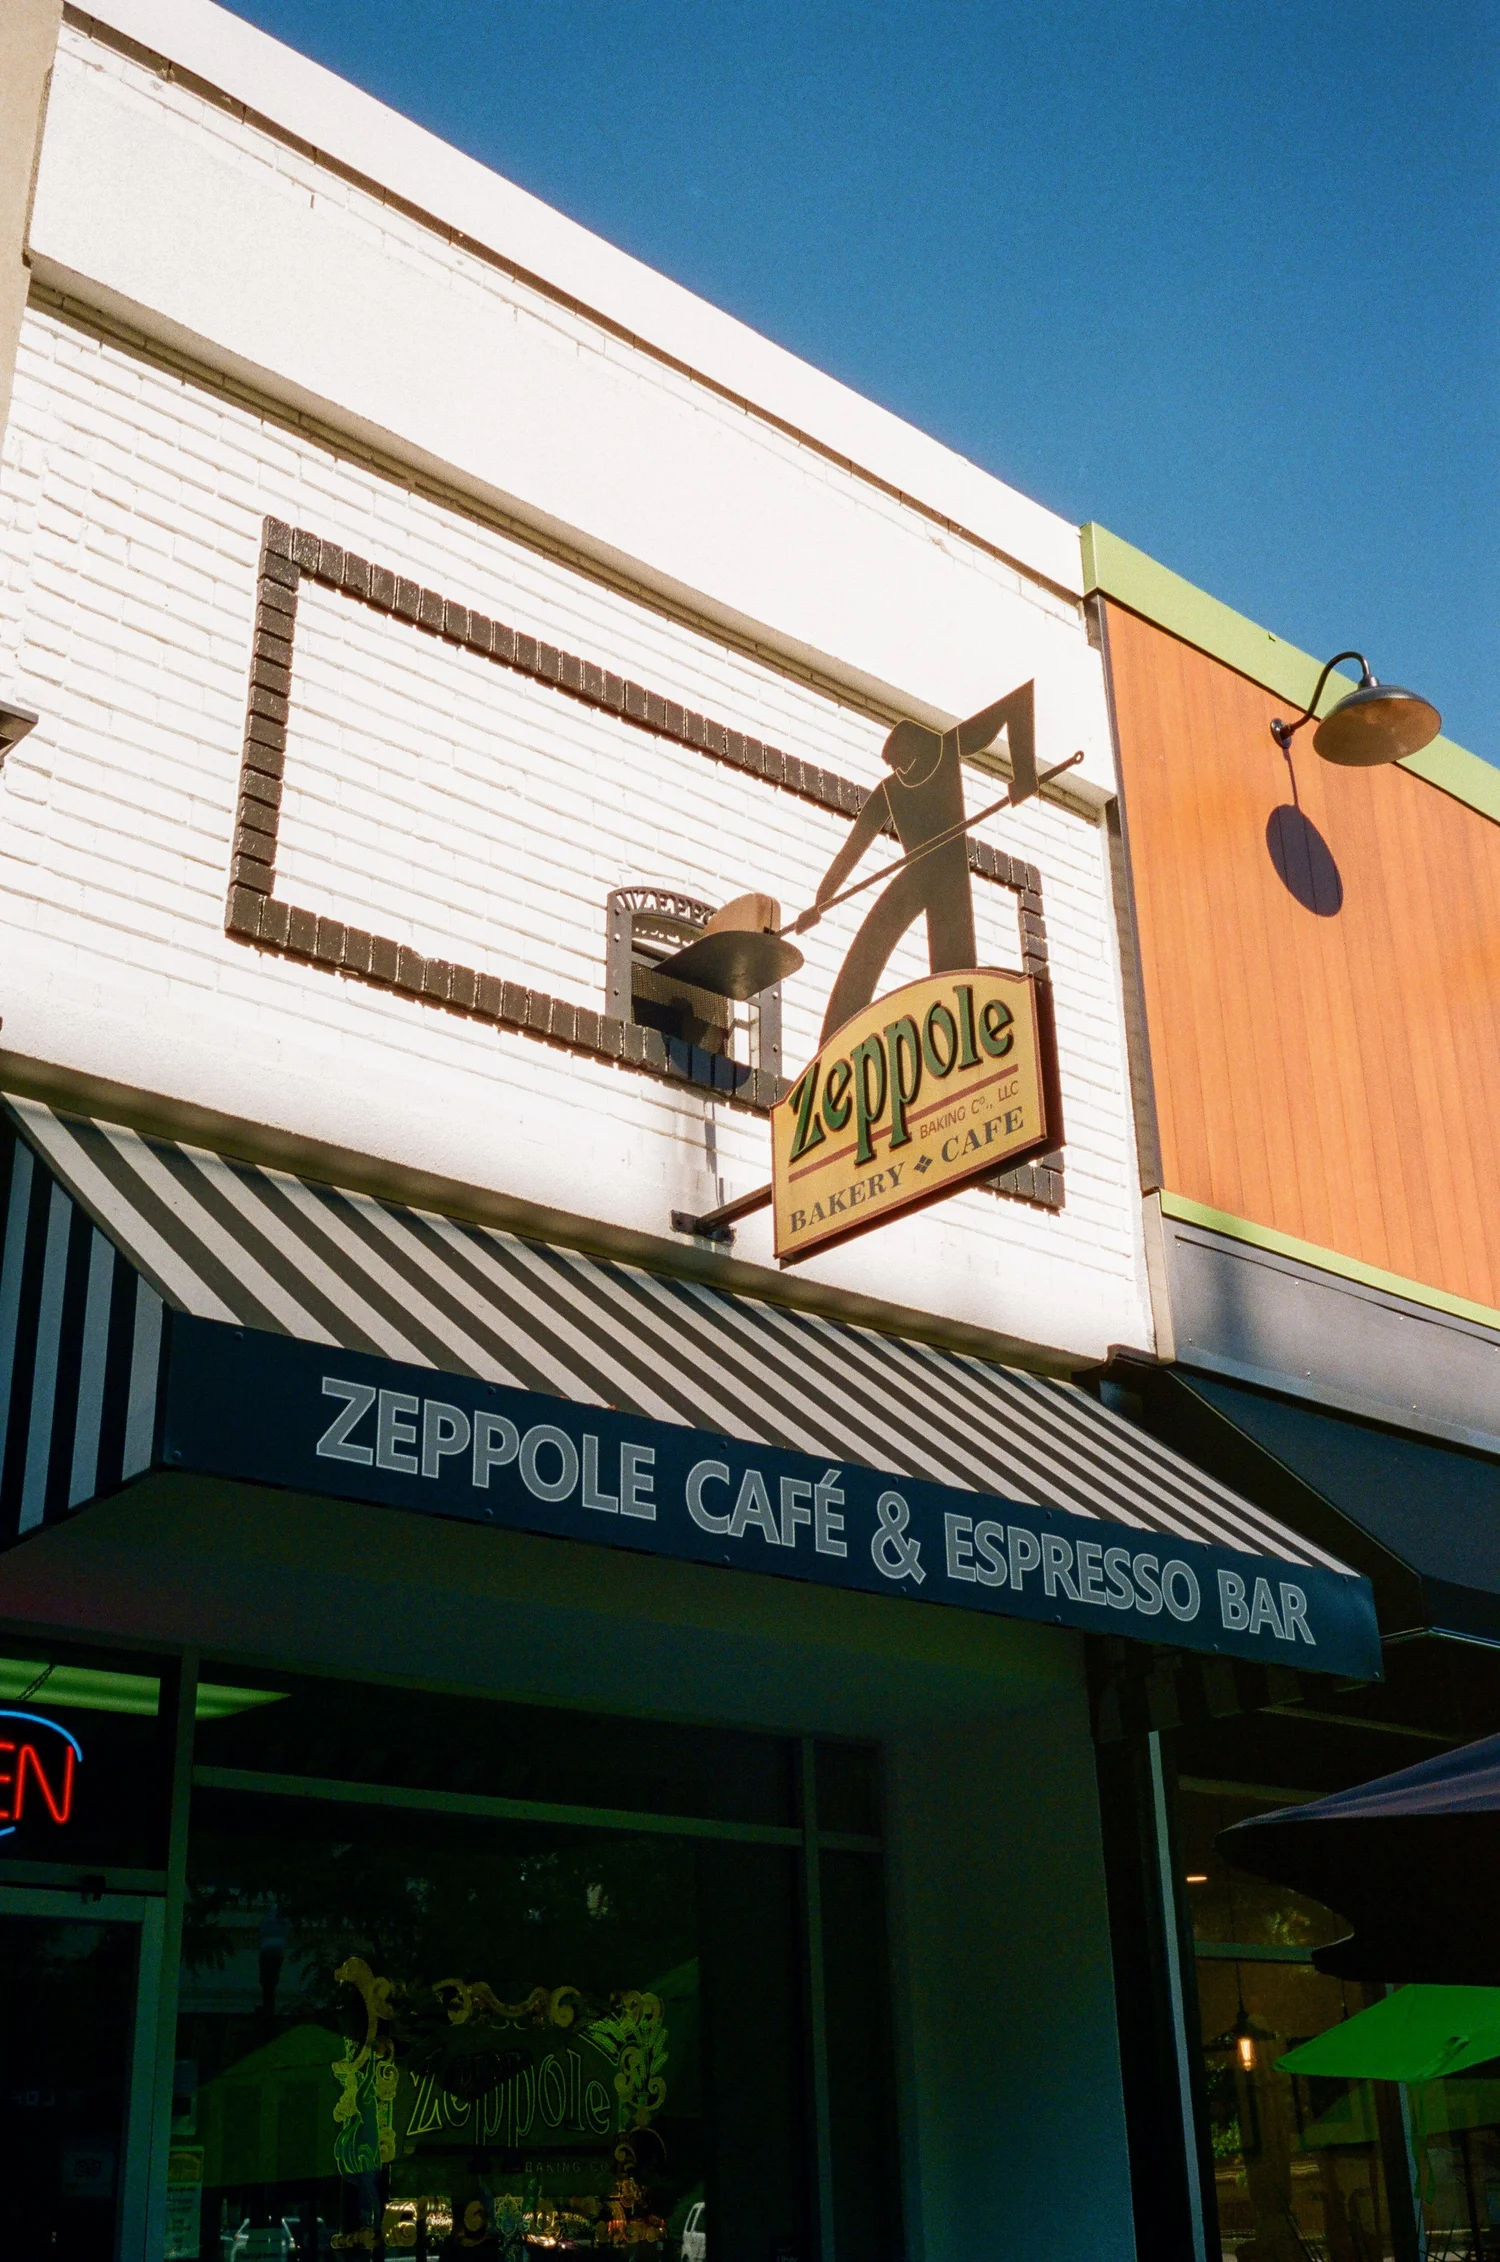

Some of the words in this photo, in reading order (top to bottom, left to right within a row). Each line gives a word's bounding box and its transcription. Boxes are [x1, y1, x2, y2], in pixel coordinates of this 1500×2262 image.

[788, 984, 1015, 1166] Zeppole
[920, 1106, 966, 1139] BAKING
[998, 1080, 1019, 1102] LLC
[789, 1161, 906, 1234] BAKERY
[941, 1105, 1024, 1162] CAFE
[316, 1376, 656, 1521] ZEPPOLE
[686, 1469, 848, 1558] CAFÉ
[871, 1491, 926, 1585] &
[944, 1512, 1201, 1622] ESPRESSO
[1217, 1568, 1317, 1646] BAR
[525, 2160, 581, 2173] BAKING
